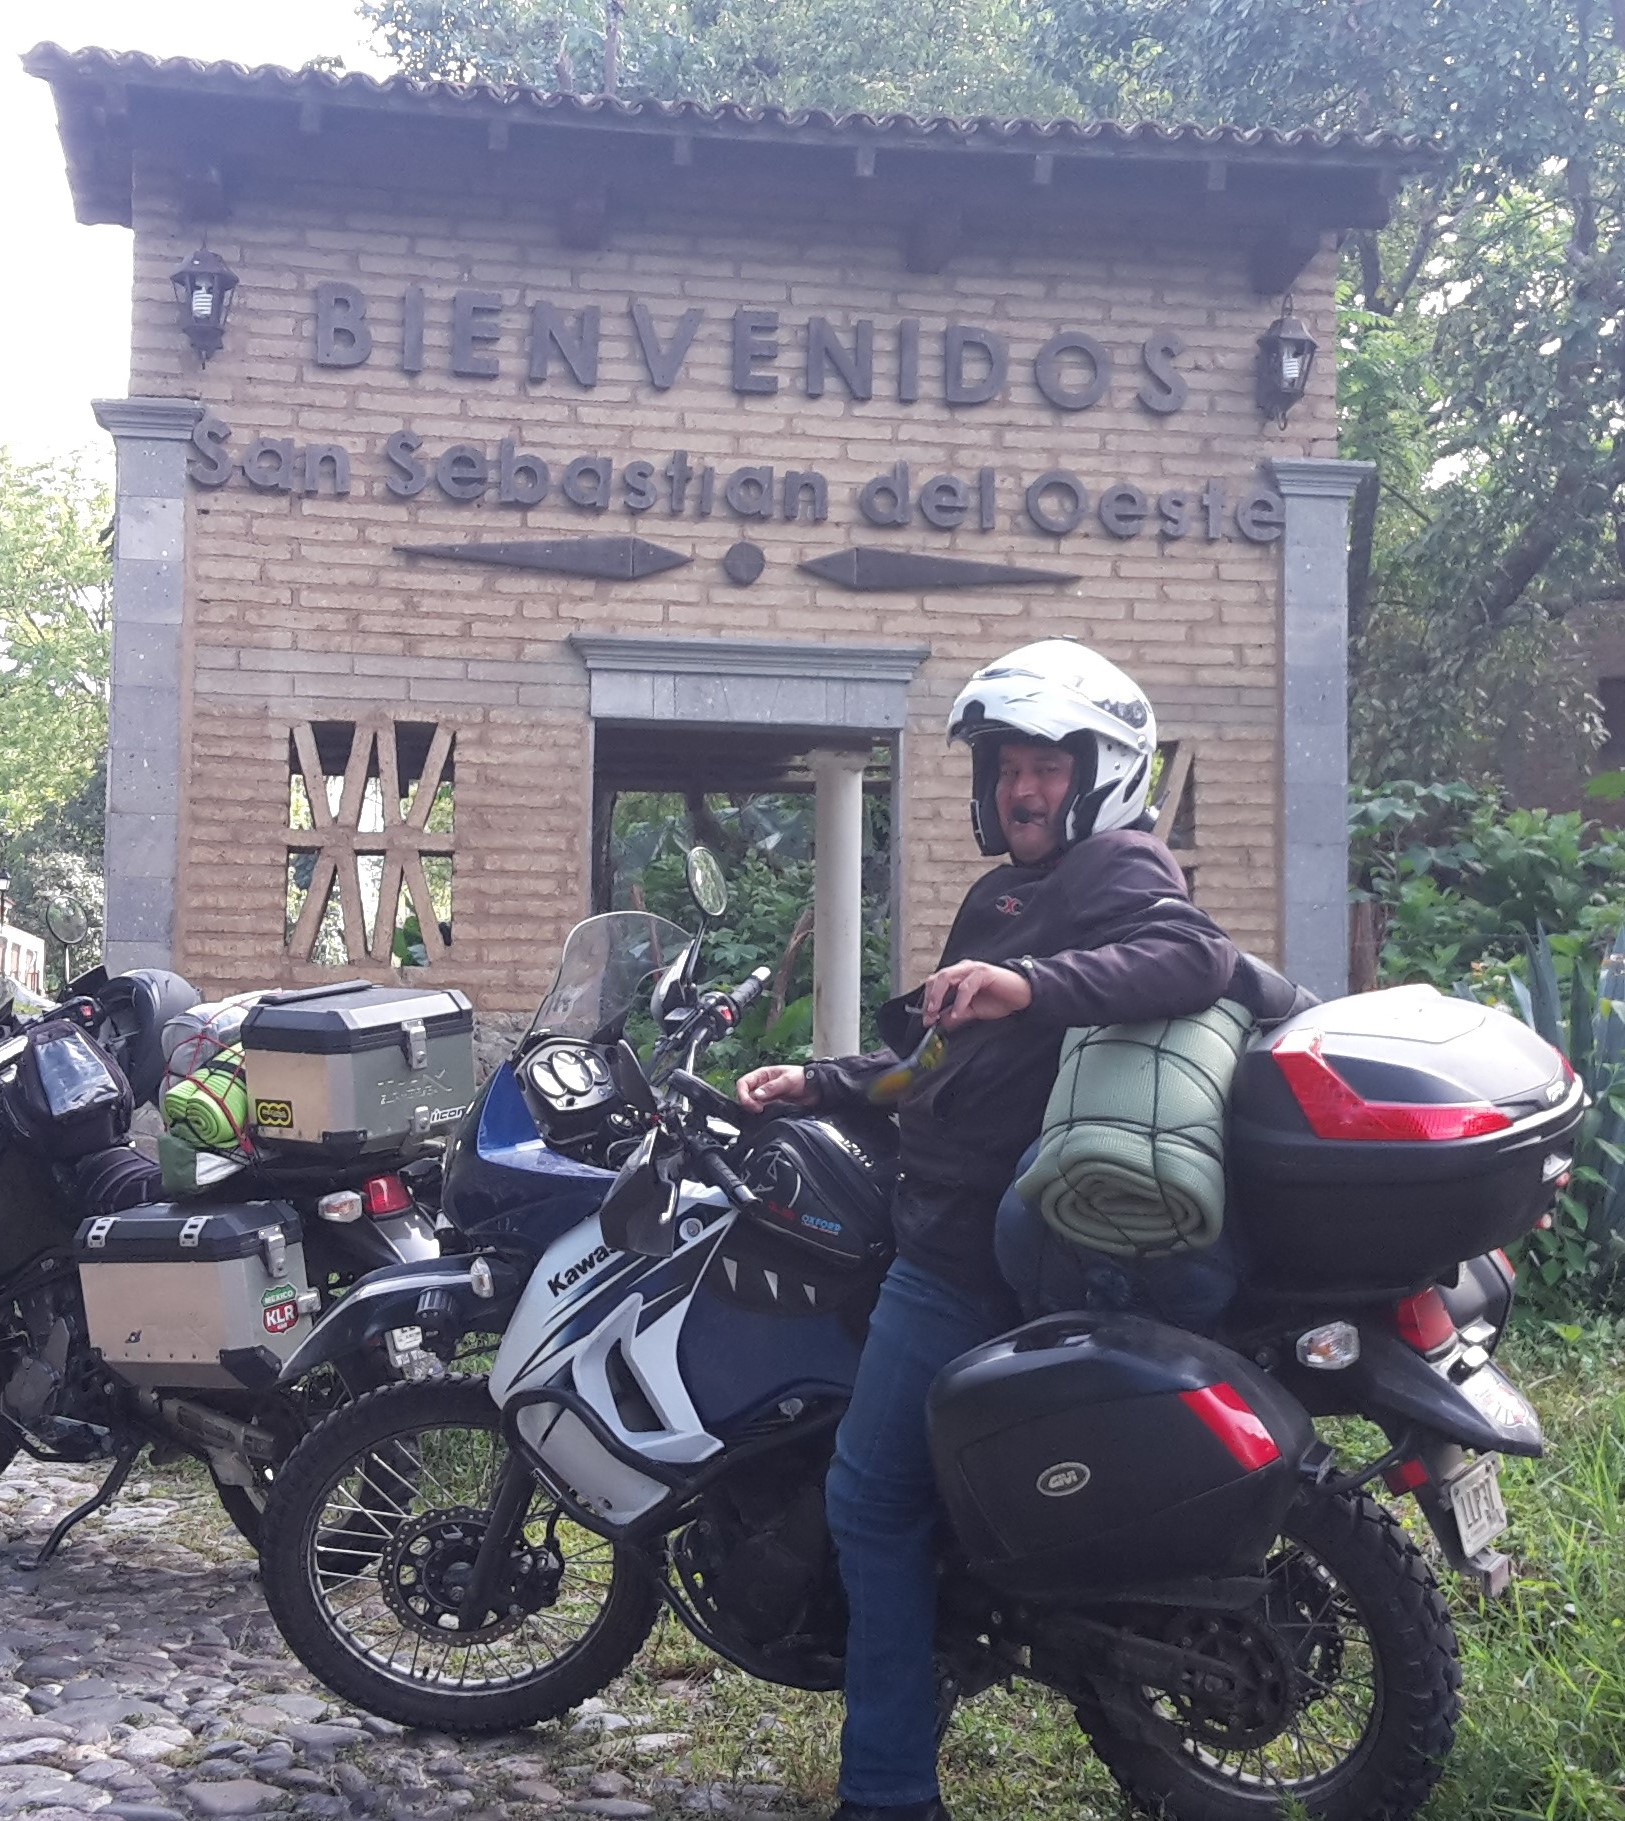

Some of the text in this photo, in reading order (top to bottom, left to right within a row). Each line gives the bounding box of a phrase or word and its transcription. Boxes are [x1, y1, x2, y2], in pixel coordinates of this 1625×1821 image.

[316, 280, 1188, 414] BIENVENIDOS
[188, 418, 1285, 543] San Sebastian del Oeste
[266, 1304, 295, 1327] KLR
